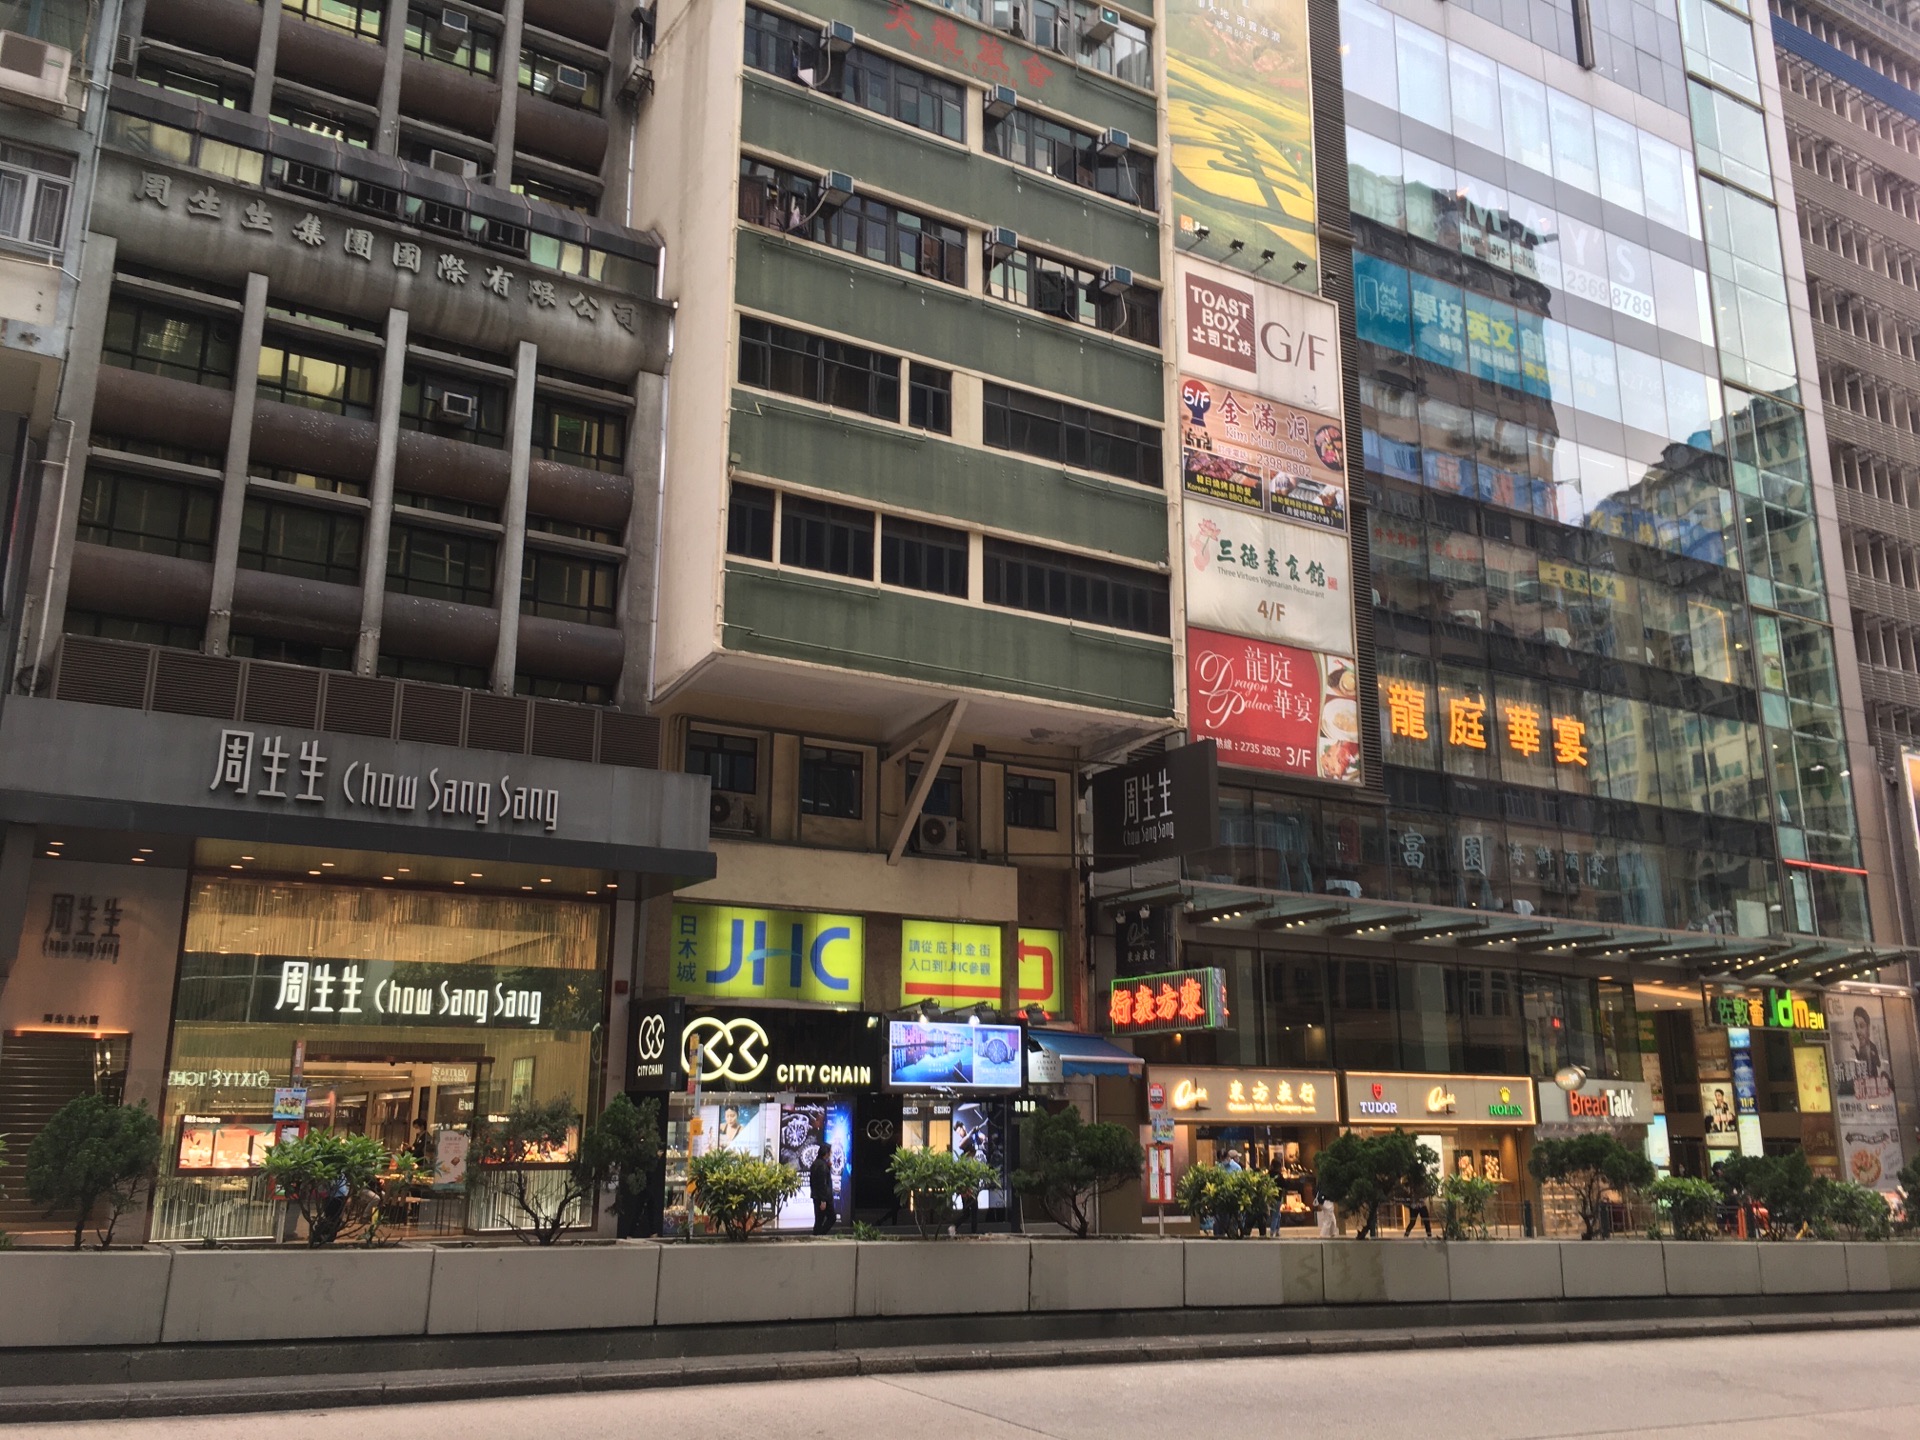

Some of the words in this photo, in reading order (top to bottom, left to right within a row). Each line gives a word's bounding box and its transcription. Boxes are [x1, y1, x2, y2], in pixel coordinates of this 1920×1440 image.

[134, 170, 640, 335] 周生生集團國際有限公司
[1190, 284, 1250, 320] TOAST
[1566, 269, 1607, 301] 2369
[1612, 287, 1653, 319] 8789
[1201, 307, 1241, 337] BOX
[1192, 325, 1252, 357] 土司工坊
[1260, 321, 1328, 372] G/F
[1182, 385, 1210, 410] 5/F
[1216, 390, 1310, 445] 金滿洞
[1226, 425, 1249, 443] Kim
[1249, 432, 1276, 451] Mun
[1277, 440, 1309, 462] Dong
[1256, 453, 1284, 471] 2398
[1286, 461, 1312, 478] 8802
[1186, 481, 1210, 495] Korean
[1209, 487, 1229, 501] Japan
[1228, 491, 1243, 504] BBQ
[1243, 495, 1262, 508] Buffet
[1217, 565, 1237, 578] Three
[1236, 570, 1260, 584] Virtues
[1260, 575, 1293, 592] Vegetarian
[1293, 583, 1325, 599] Restaurant
[1257, 600, 1286, 622] 4/F
[1195, 650, 1268, 697] Dragon
[1244, 645, 1294, 688] 龍庭
[1206, 688, 1274, 730] Palace
[1273, 688, 1314, 724] 華宴
[1386, 682, 1589, 767] 龍庭華宴
[1240, 740, 1260, 755] 2735
[1261, 744, 1282, 758] 2832
[1285, 746, 1312, 768] 3/F
[209, 728, 329, 803] 周生生
[343, 760, 419, 812] Chow
[428, 766, 492, 826] Sang
[498, 773, 560, 832] Sang
[1122, 767, 1174, 827] 周生生
[1141, 825, 1158, 844] Sang
[1157, 820, 1175, 840] Sang
[45, 893, 124, 939] 周生生
[705, 917, 851, 991] JHC
[274, 960, 364, 1016] 周生生
[374, 980, 433, 1016] Chow
[438, 980, 489, 1026] Sang
[494, 981, 543, 1027] Sang
[637, 1064, 649, 1077] CITY
[648, 1063, 664, 1076] CHAIN
[776, 1063, 815, 1084] CITY
[818, 1065, 872, 1086] CHAIN
[1359, 1101, 1399, 1115] TUDOR
[1488, 1103, 1524, 1117] ROLEX
[1569, 1088, 1636, 1118] BreadTalk
